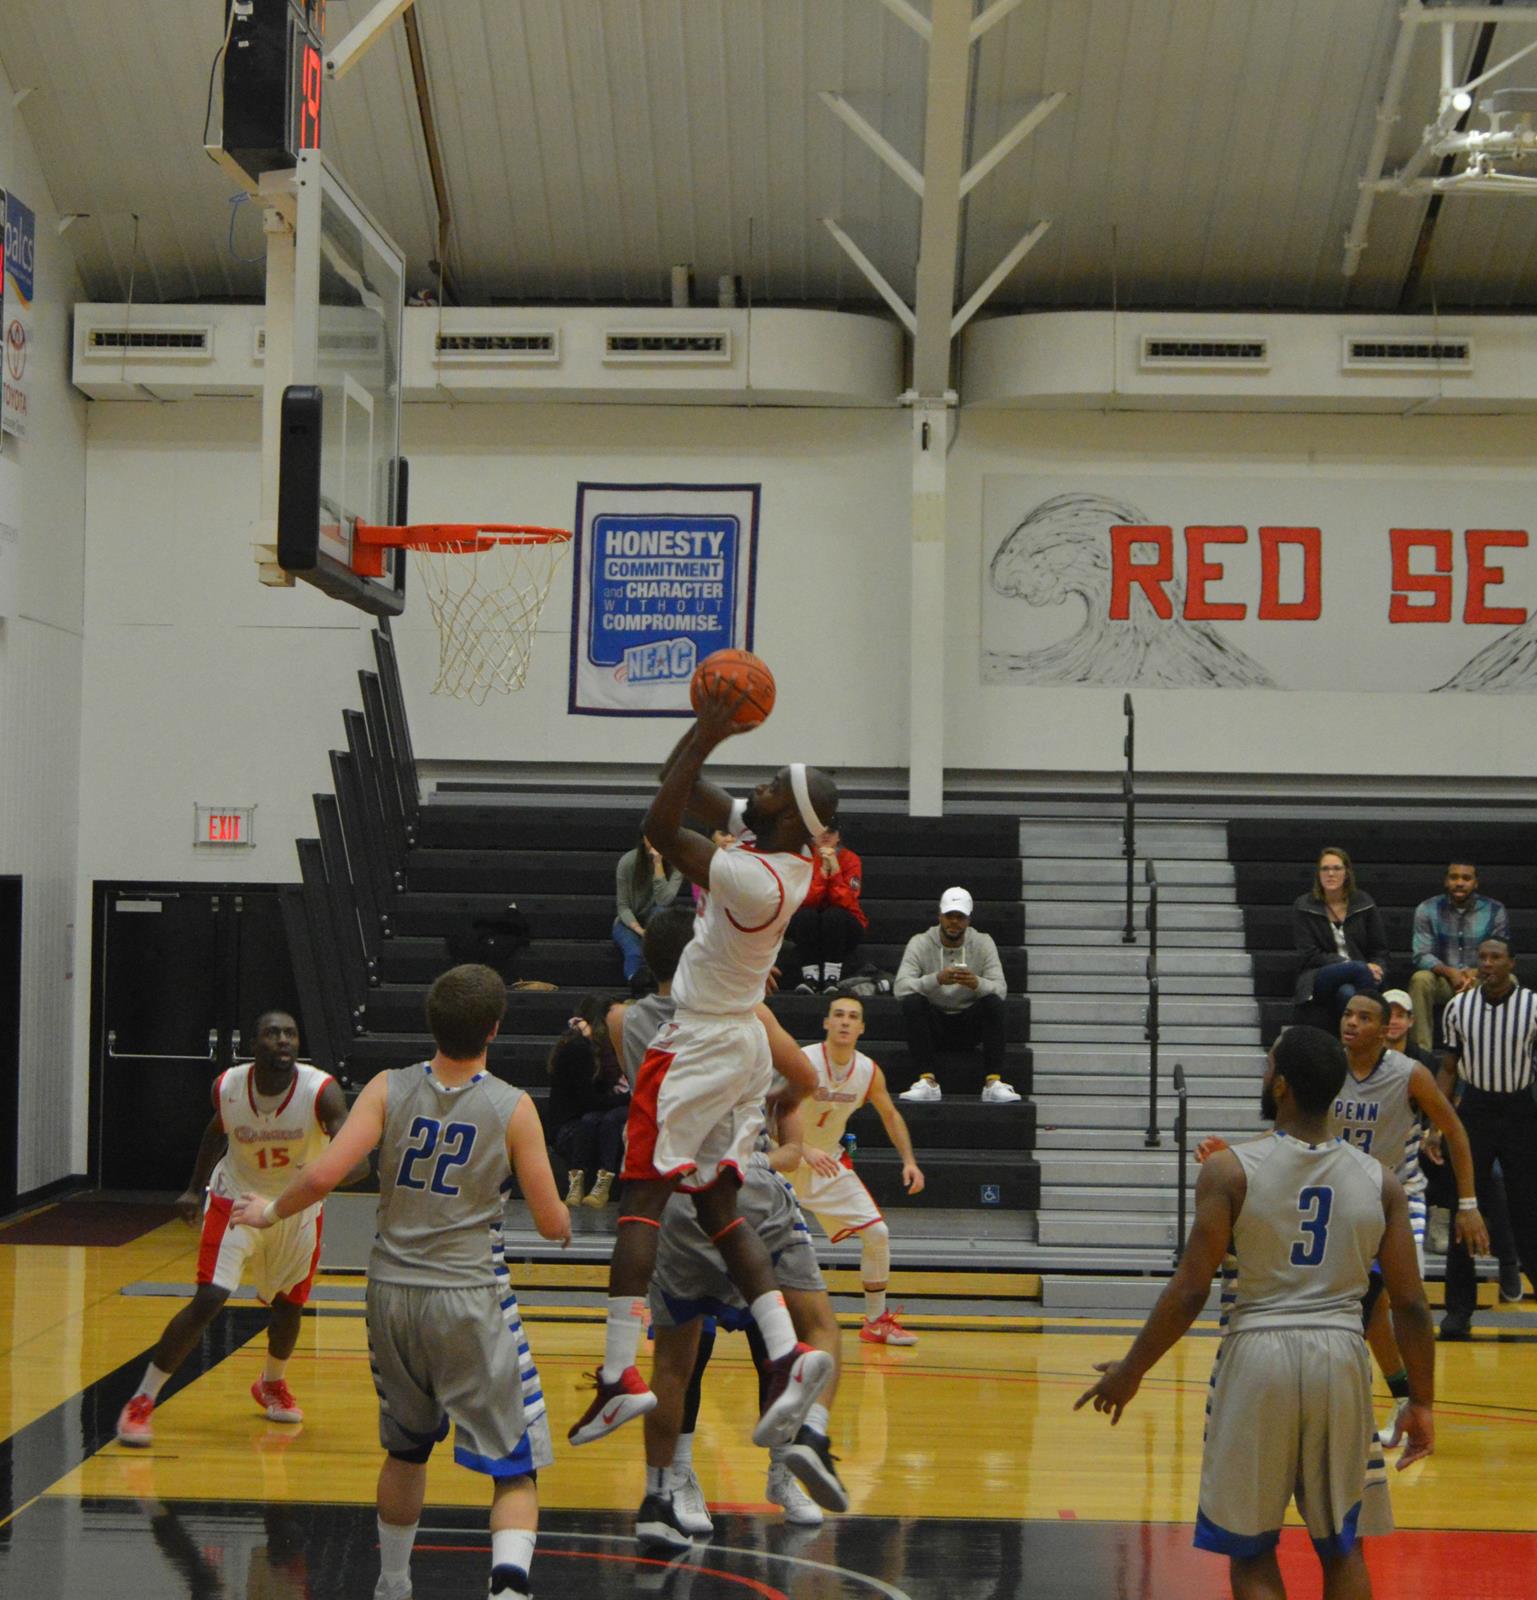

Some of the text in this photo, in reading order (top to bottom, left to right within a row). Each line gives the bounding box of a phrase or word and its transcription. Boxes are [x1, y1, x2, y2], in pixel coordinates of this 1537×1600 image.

[605, 530, 725, 558] HONESTY,
[608, 561, 721, 577] COMMITMENT
[1108, 525, 1322, 621] RED
[603, 581, 724, 599] and CHARACTER
[604, 599, 724, 613] WITHOUT
[602, 613, 723, 631] COMPROMISE.
[626, 641, 695, 682] NEAC
[209, 815, 241, 842] EXIT
[1334, 1099, 1380, 1122] PENN
[254, 1147, 290, 1169] 15
[395, 1115, 478, 1197] 22
[1288, 1184, 1335, 1268] 3
